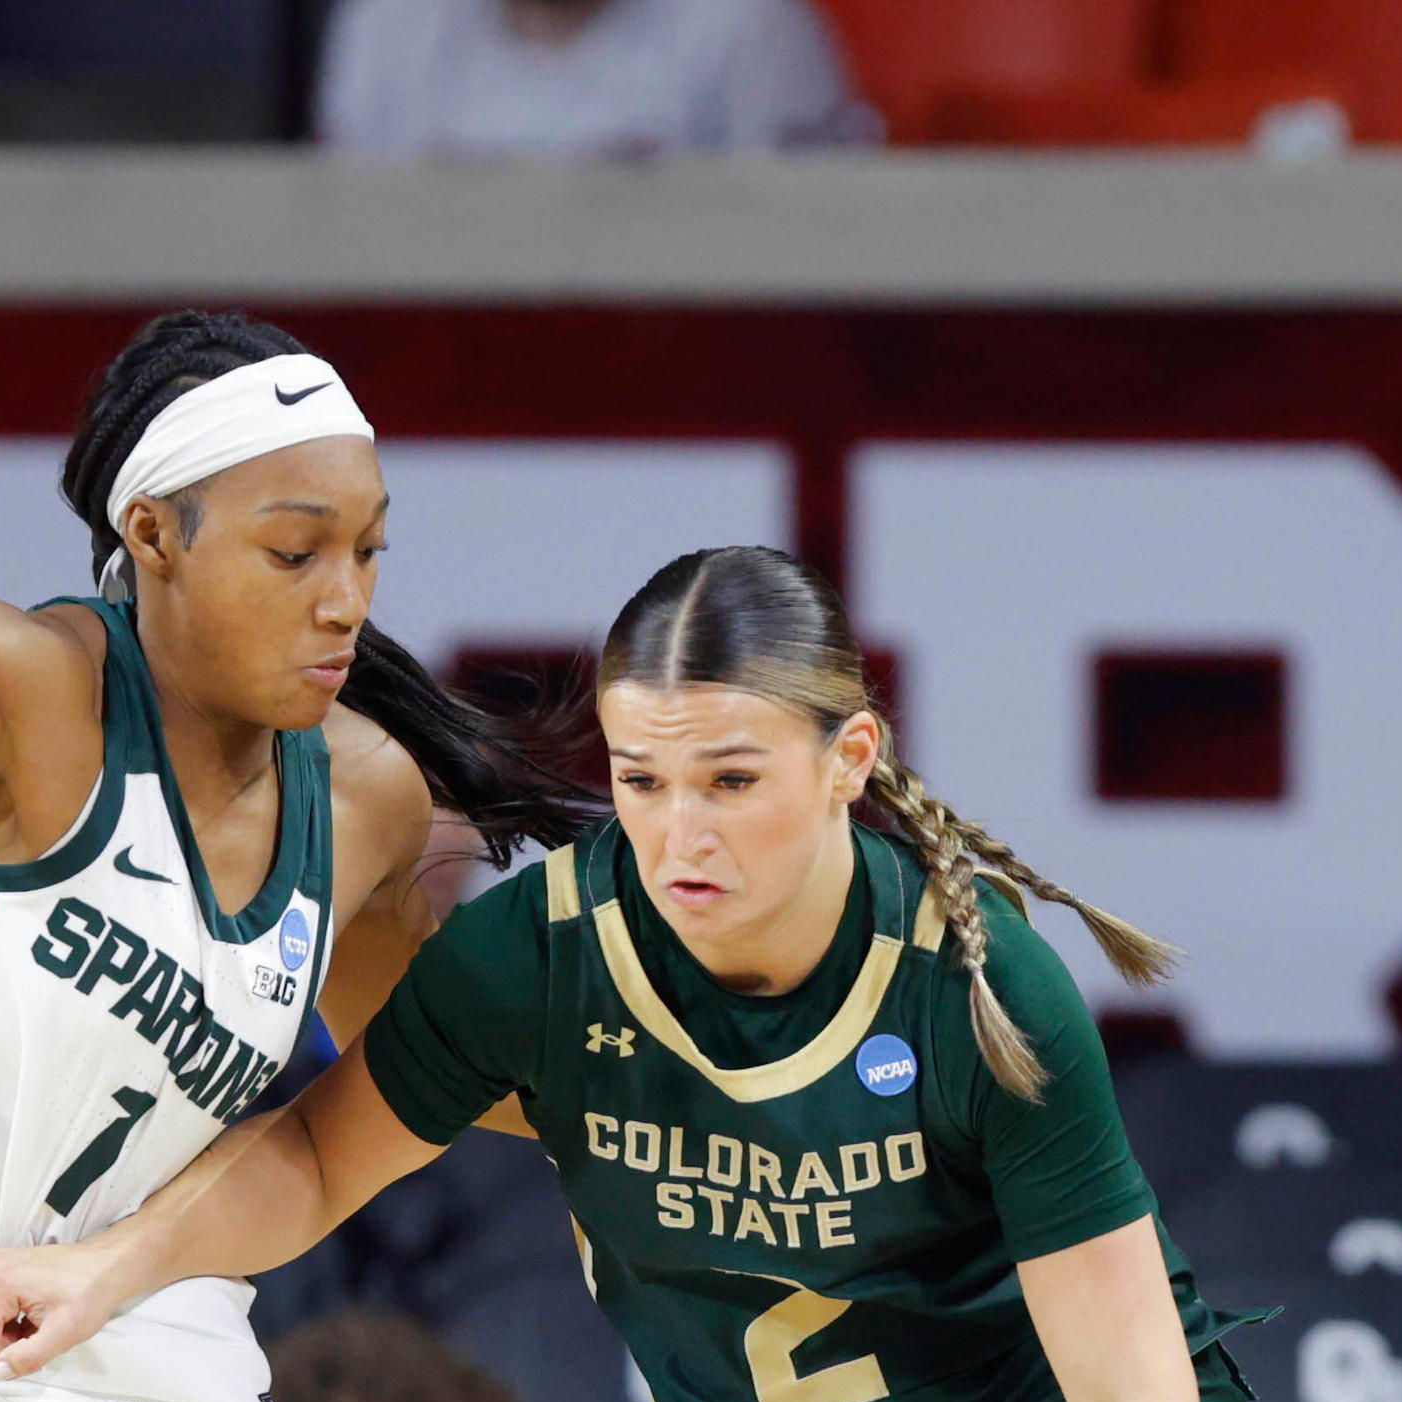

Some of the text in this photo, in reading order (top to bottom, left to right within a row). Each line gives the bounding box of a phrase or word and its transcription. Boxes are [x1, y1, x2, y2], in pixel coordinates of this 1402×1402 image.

[31, 897, 281, 1127] SPARTANS
[866, 1058, 914, 1086] NCAA
[44, 1083, 158, 1217] 1
[584, 1111, 927, 1199] COLORADO
[655, 1182, 856, 1249] STATE
